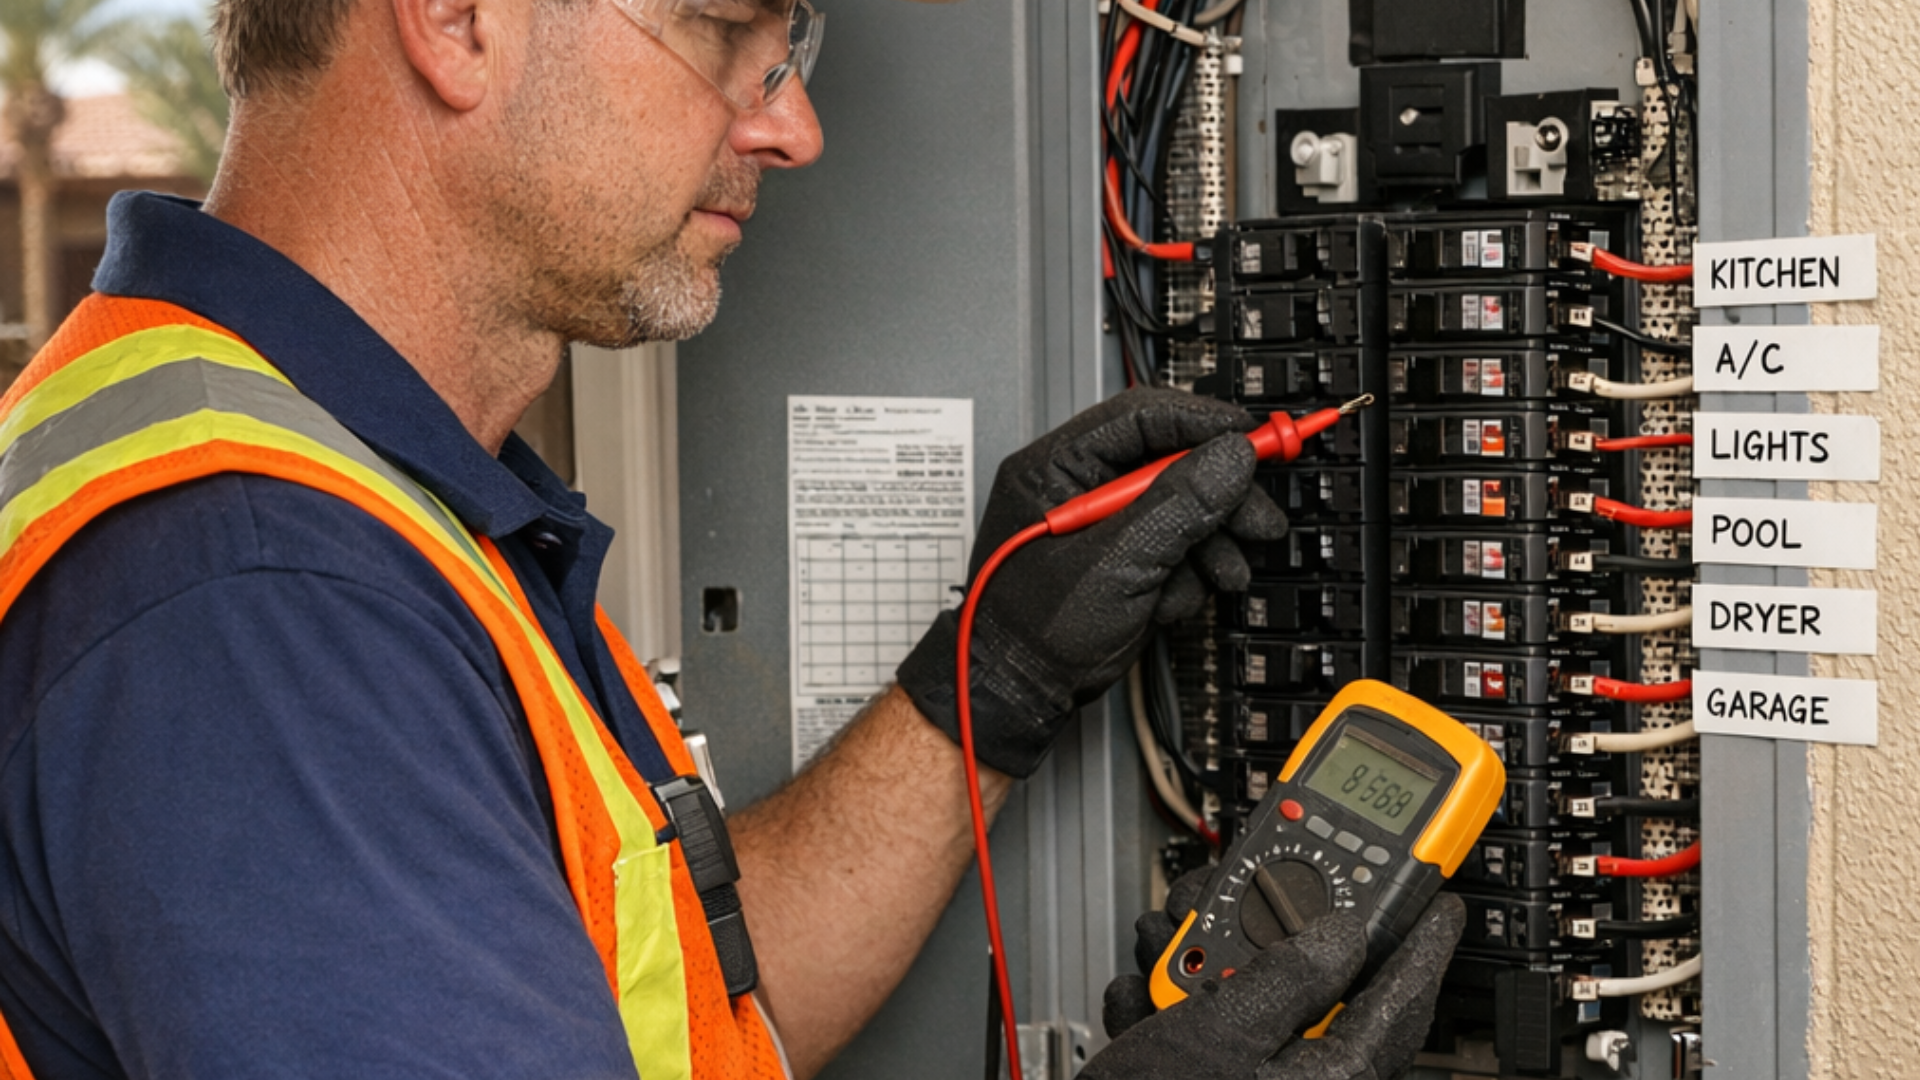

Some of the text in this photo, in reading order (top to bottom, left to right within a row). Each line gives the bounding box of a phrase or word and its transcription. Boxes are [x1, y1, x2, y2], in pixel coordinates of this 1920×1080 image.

[1711, 256, 1840, 290] KITCHEN
[1715, 340, 1784, 380] A/C
[1711, 428, 1829, 463] LIGHTS
[1712, 514, 1802, 549] POOL
[1710, 601, 1821, 636] DRYER
[1707, 688, 1829, 724] GARAGE
